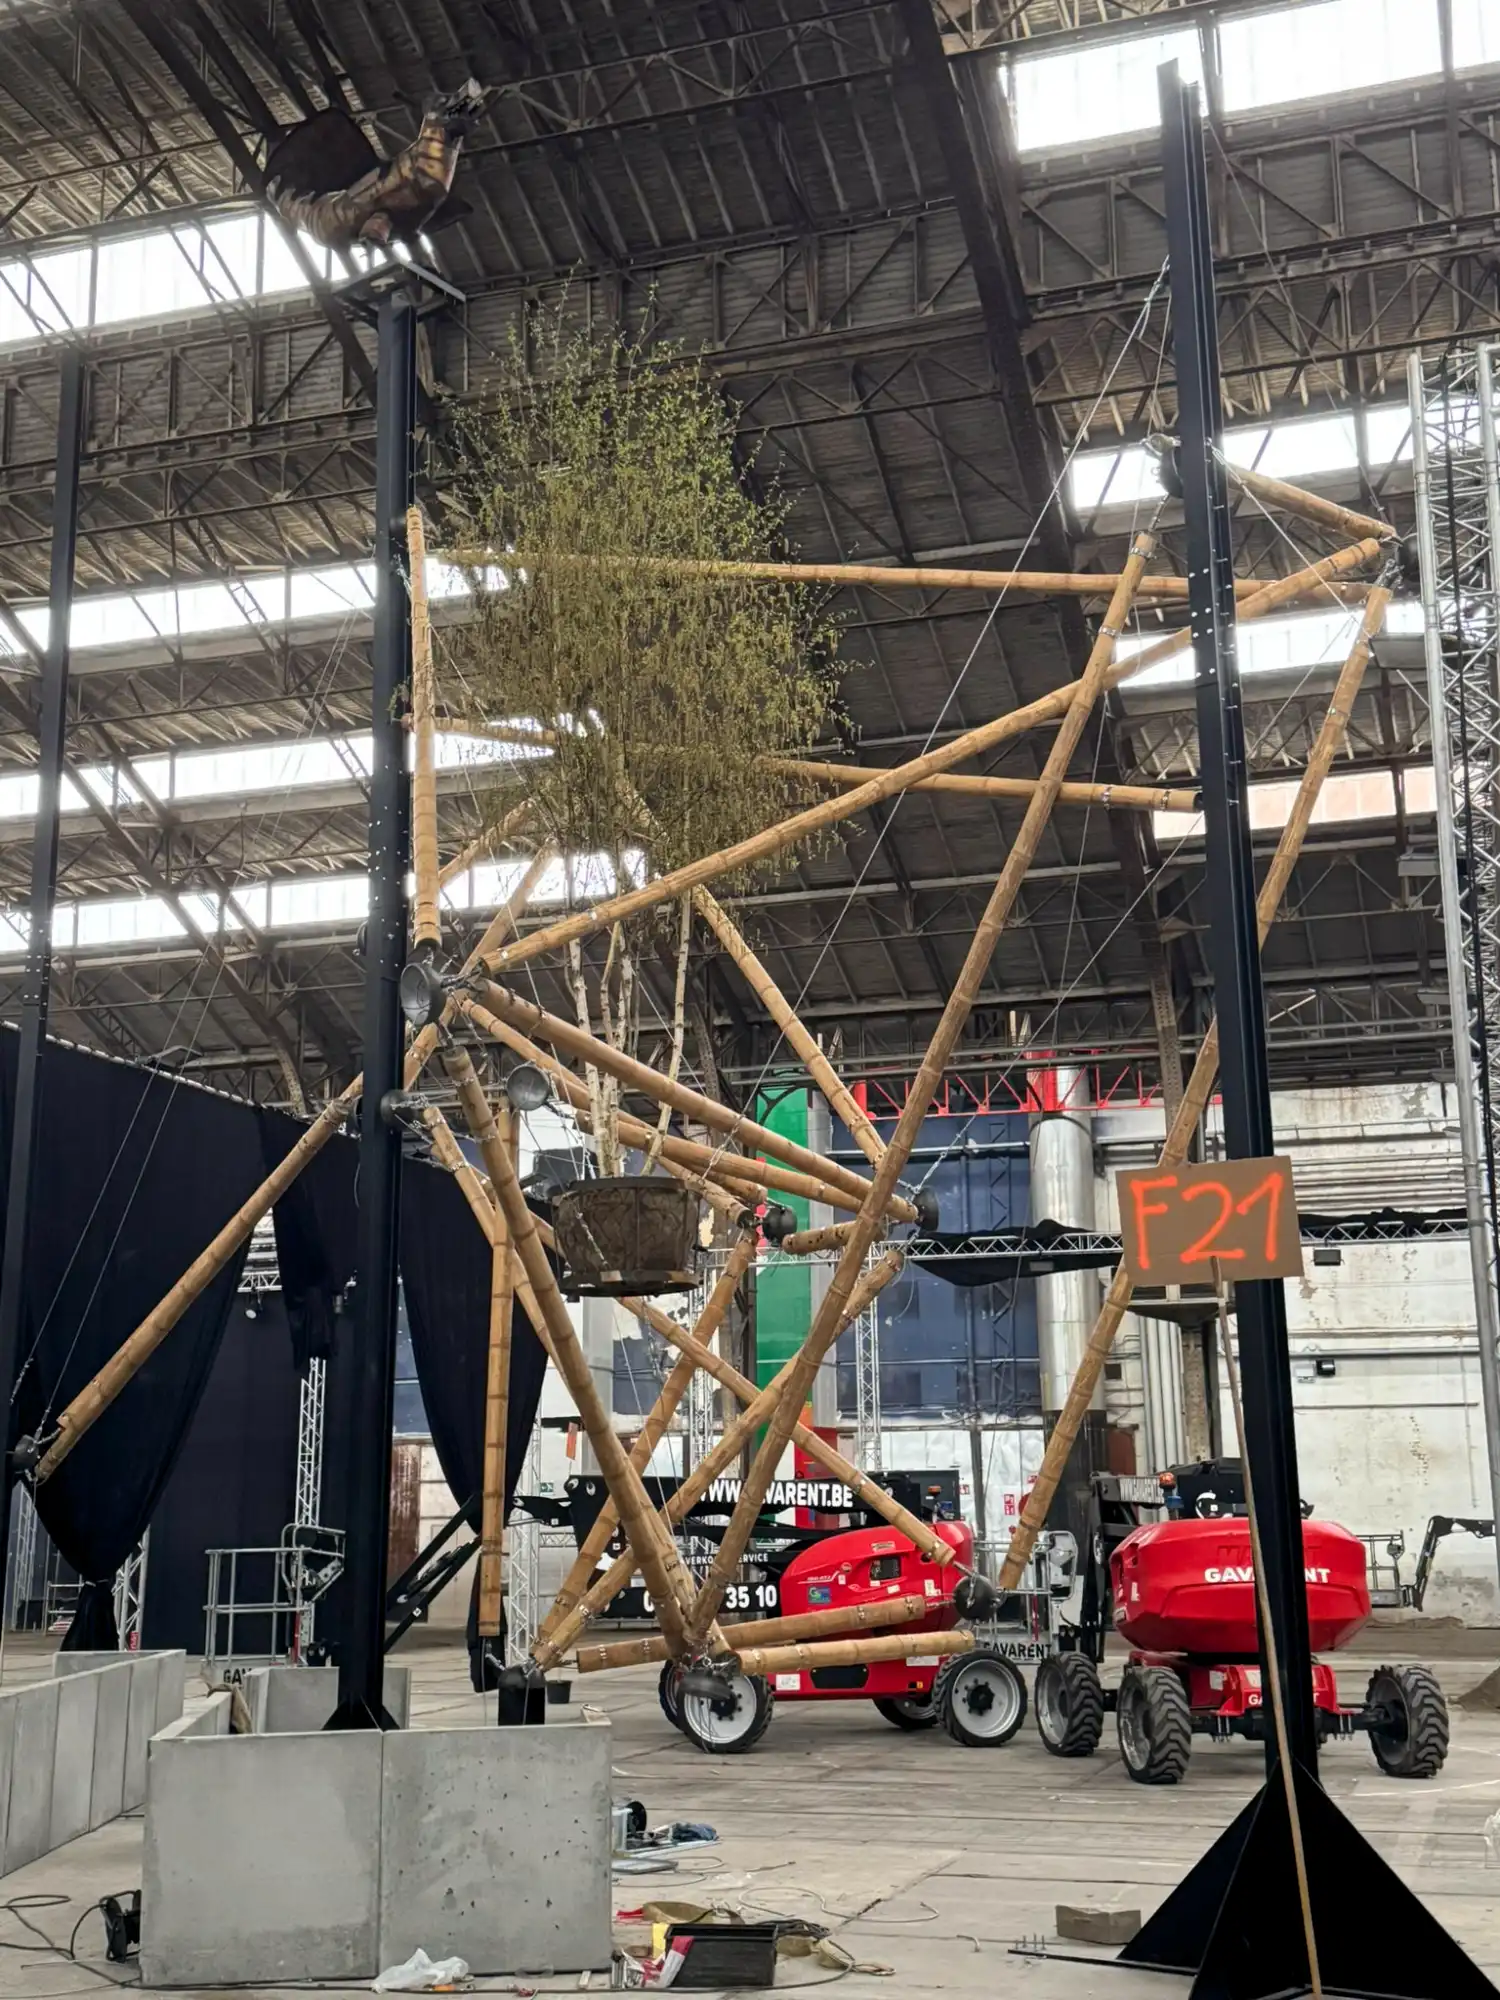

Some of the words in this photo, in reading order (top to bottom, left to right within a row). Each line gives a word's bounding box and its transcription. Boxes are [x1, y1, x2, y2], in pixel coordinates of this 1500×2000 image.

[1129, 1172, 1284, 1271] F21
[700, 1479, 854, 1508] WWVARENT.BE
[738, 1553, 769, 1563] ERVICE
[1204, 1567, 1331, 1583] GAVNT
[725, 1585, 750, 1609] 35
[755, 1584, 778, 1608] 10
